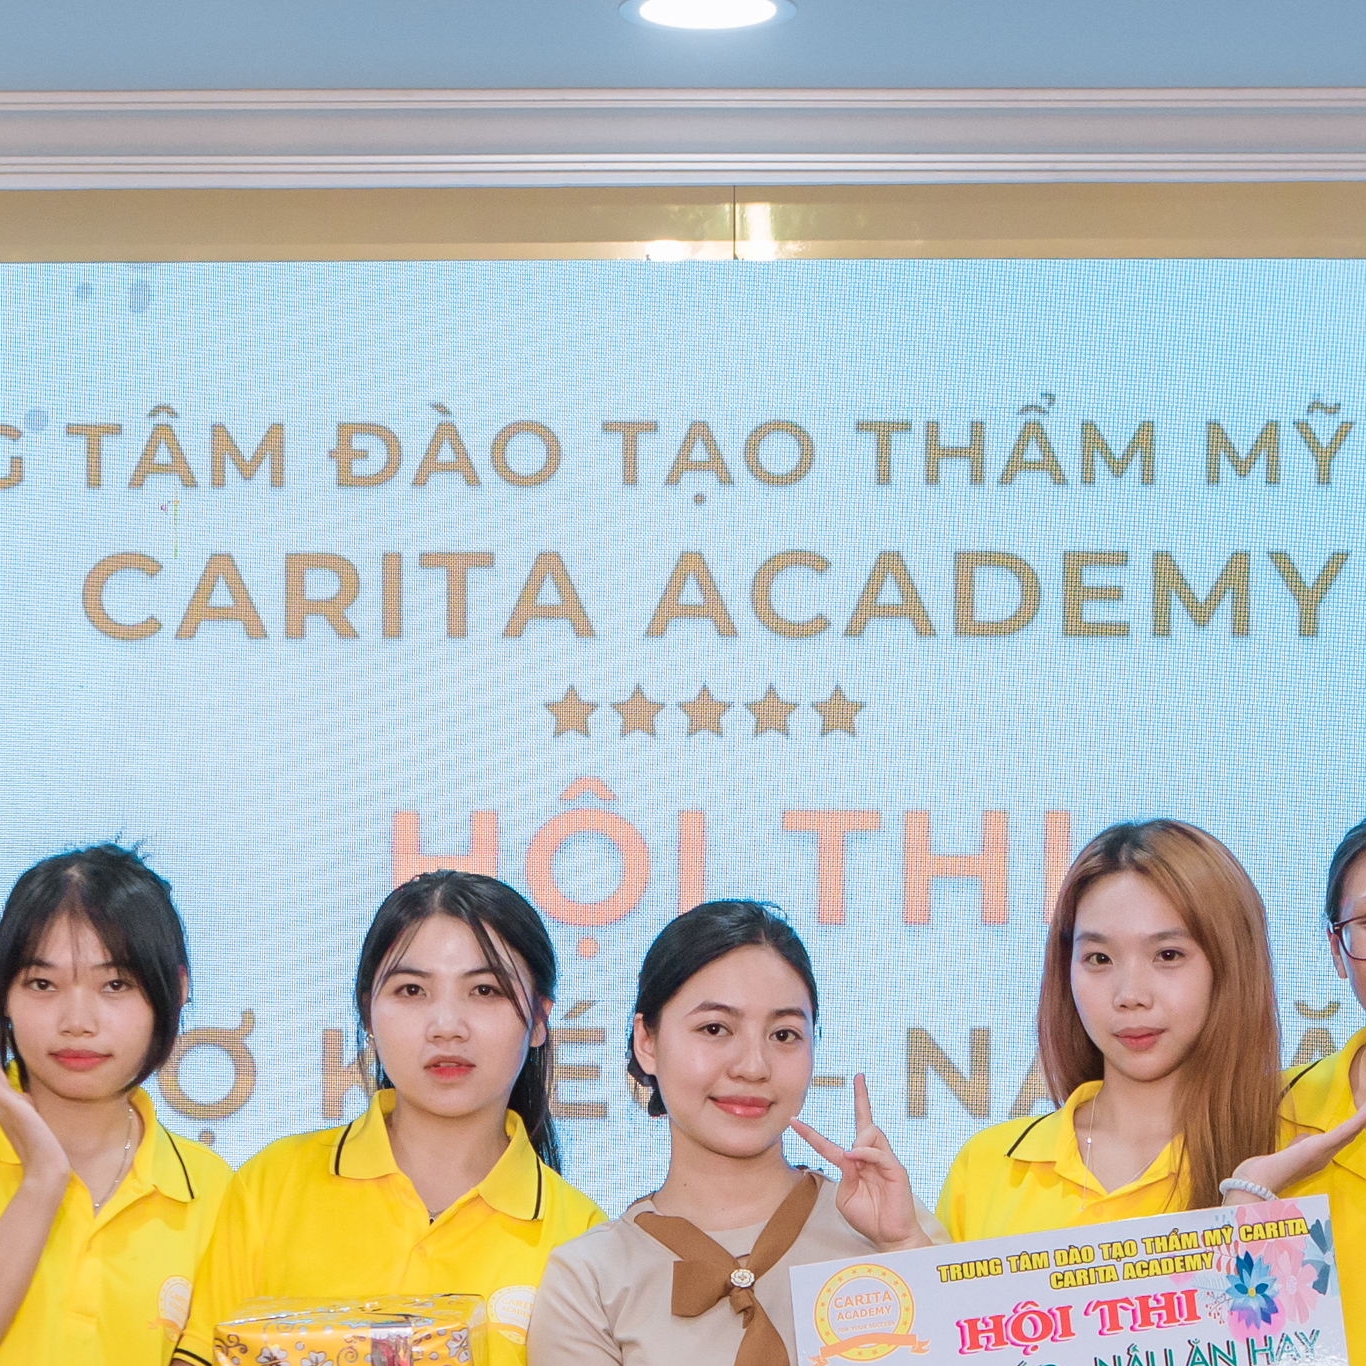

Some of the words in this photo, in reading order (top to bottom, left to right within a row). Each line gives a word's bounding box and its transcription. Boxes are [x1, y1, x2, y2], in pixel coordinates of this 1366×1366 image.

[66, 403, 285, 489] TÂM
[327, 401, 563, 487] ĐÀO
[602, 419, 816, 505] TẠO
[856, 393, 1156, 486] THẨM
[1205, 398, 1356, 486] MỸ
[81, 550, 597, 641] CARITA
[644, 549, 1353, 639] ACADEMY
[392, 776, 706, 958] HỘI
[782, 809, 1071, 926] THI
[937, 1257, 1003, 1283] TRUNG
[1006, 1250, 1050, 1273] TÂM
[1054, 1245, 1095, 1267] ĐÀO
[1098, 1239, 1138, 1262] TẠO
[1142, 1228, 1199, 1255] THẨM
[1203, 1224, 1234, 1247] MỸ
[1239, 1217, 1310, 1242] CARITA
[1050, 1264, 1119, 1290] CARITA
[1123, 1251, 1215, 1280] ACADEMY
[501, 1298, 534, 1310] CARIT
[501, 1306, 531, 1319] ACADE
[833, 1290, 893, 1309] CARITA
[837, 1305, 892, 1321] ACADEMY
[956, 1300, 1077, 1356] HỘI
[1083, 1289, 1202, 1336] THI
